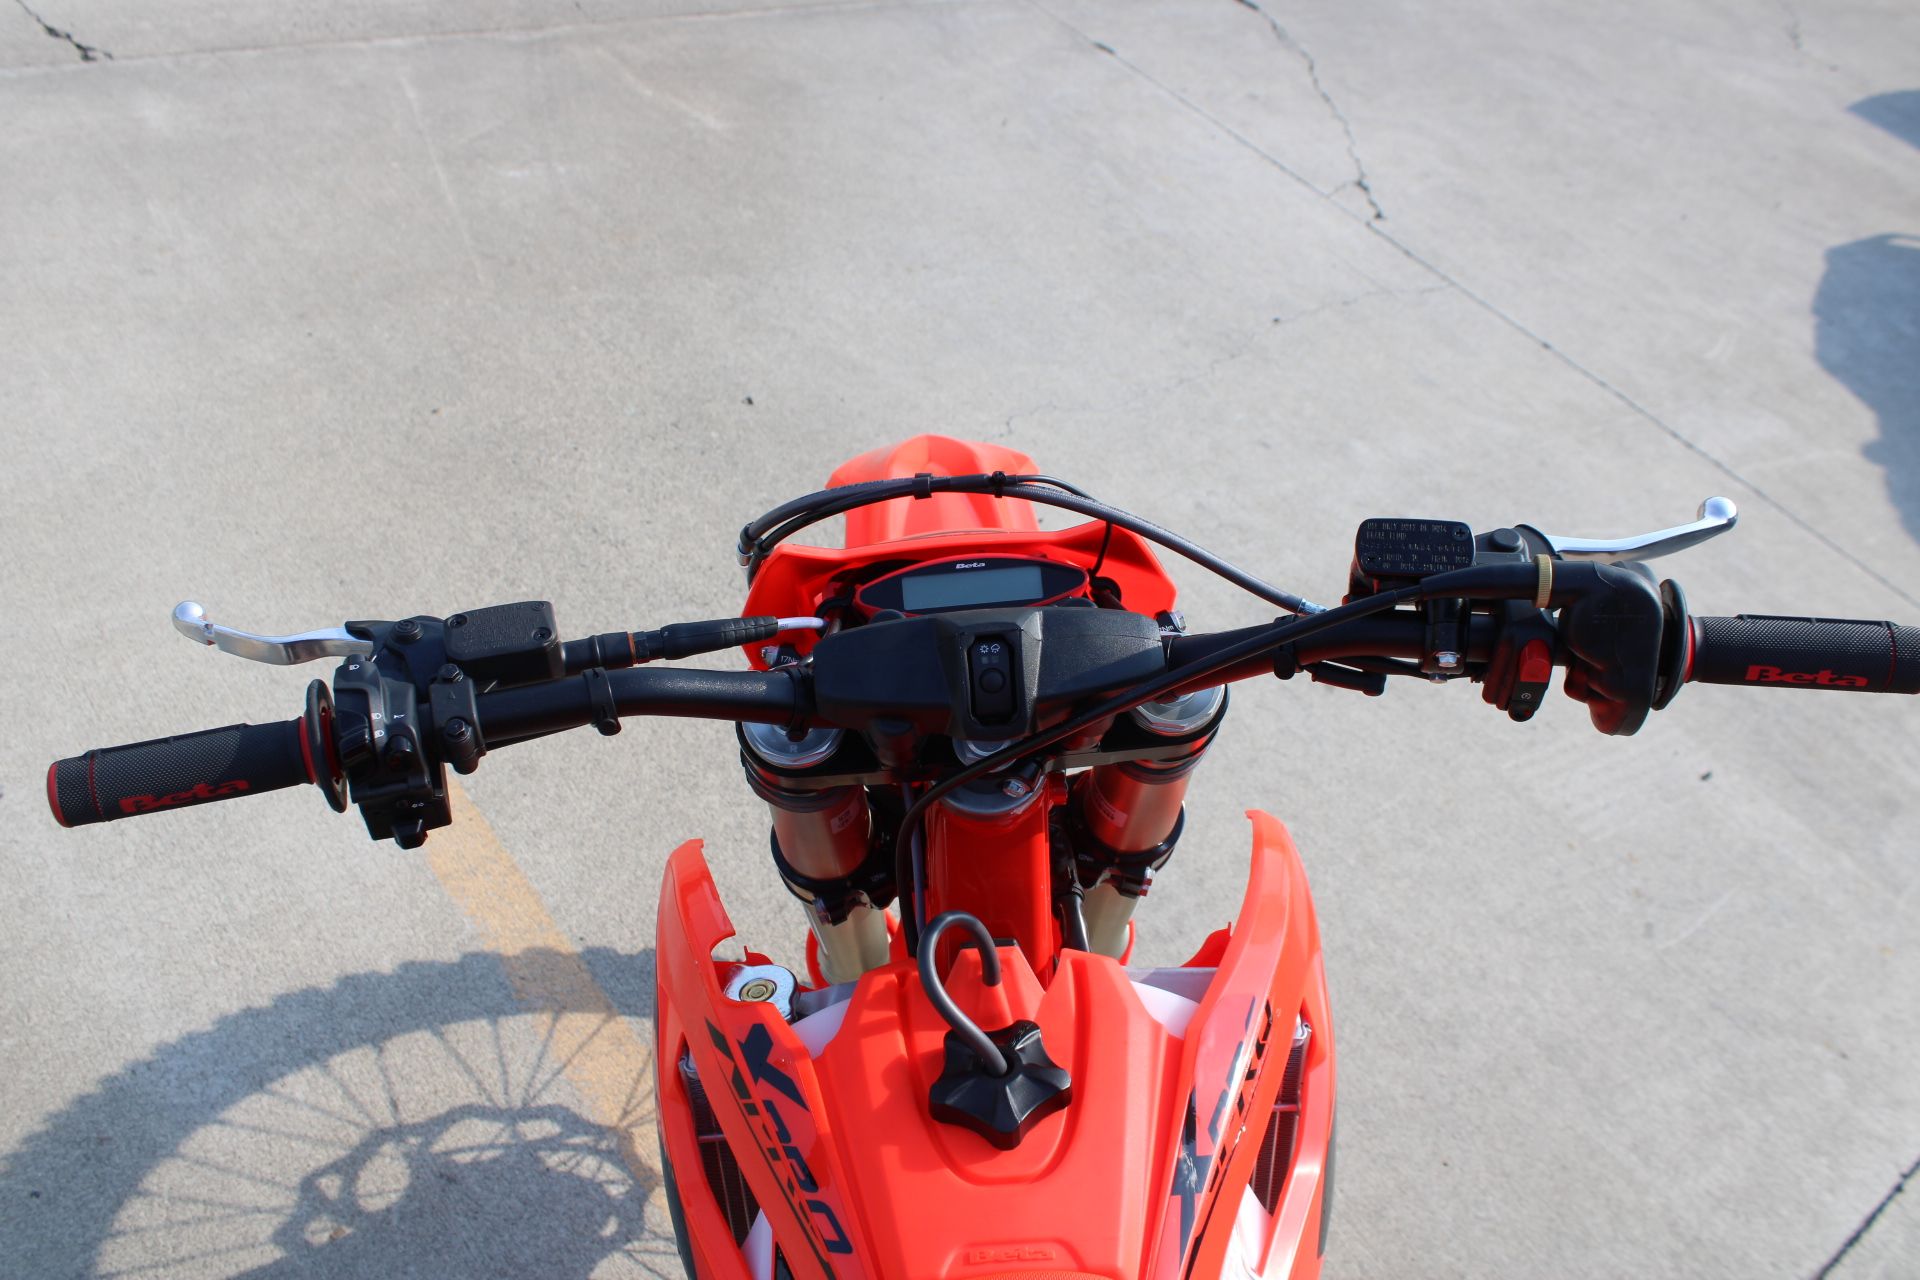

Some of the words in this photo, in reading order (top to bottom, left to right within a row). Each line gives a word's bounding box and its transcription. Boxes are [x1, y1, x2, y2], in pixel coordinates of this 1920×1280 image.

[1744, 664, 1869, 687] Beta
[118, 779, 250, 813] Beta
[963, 1247, 1056, 1266] Beta
